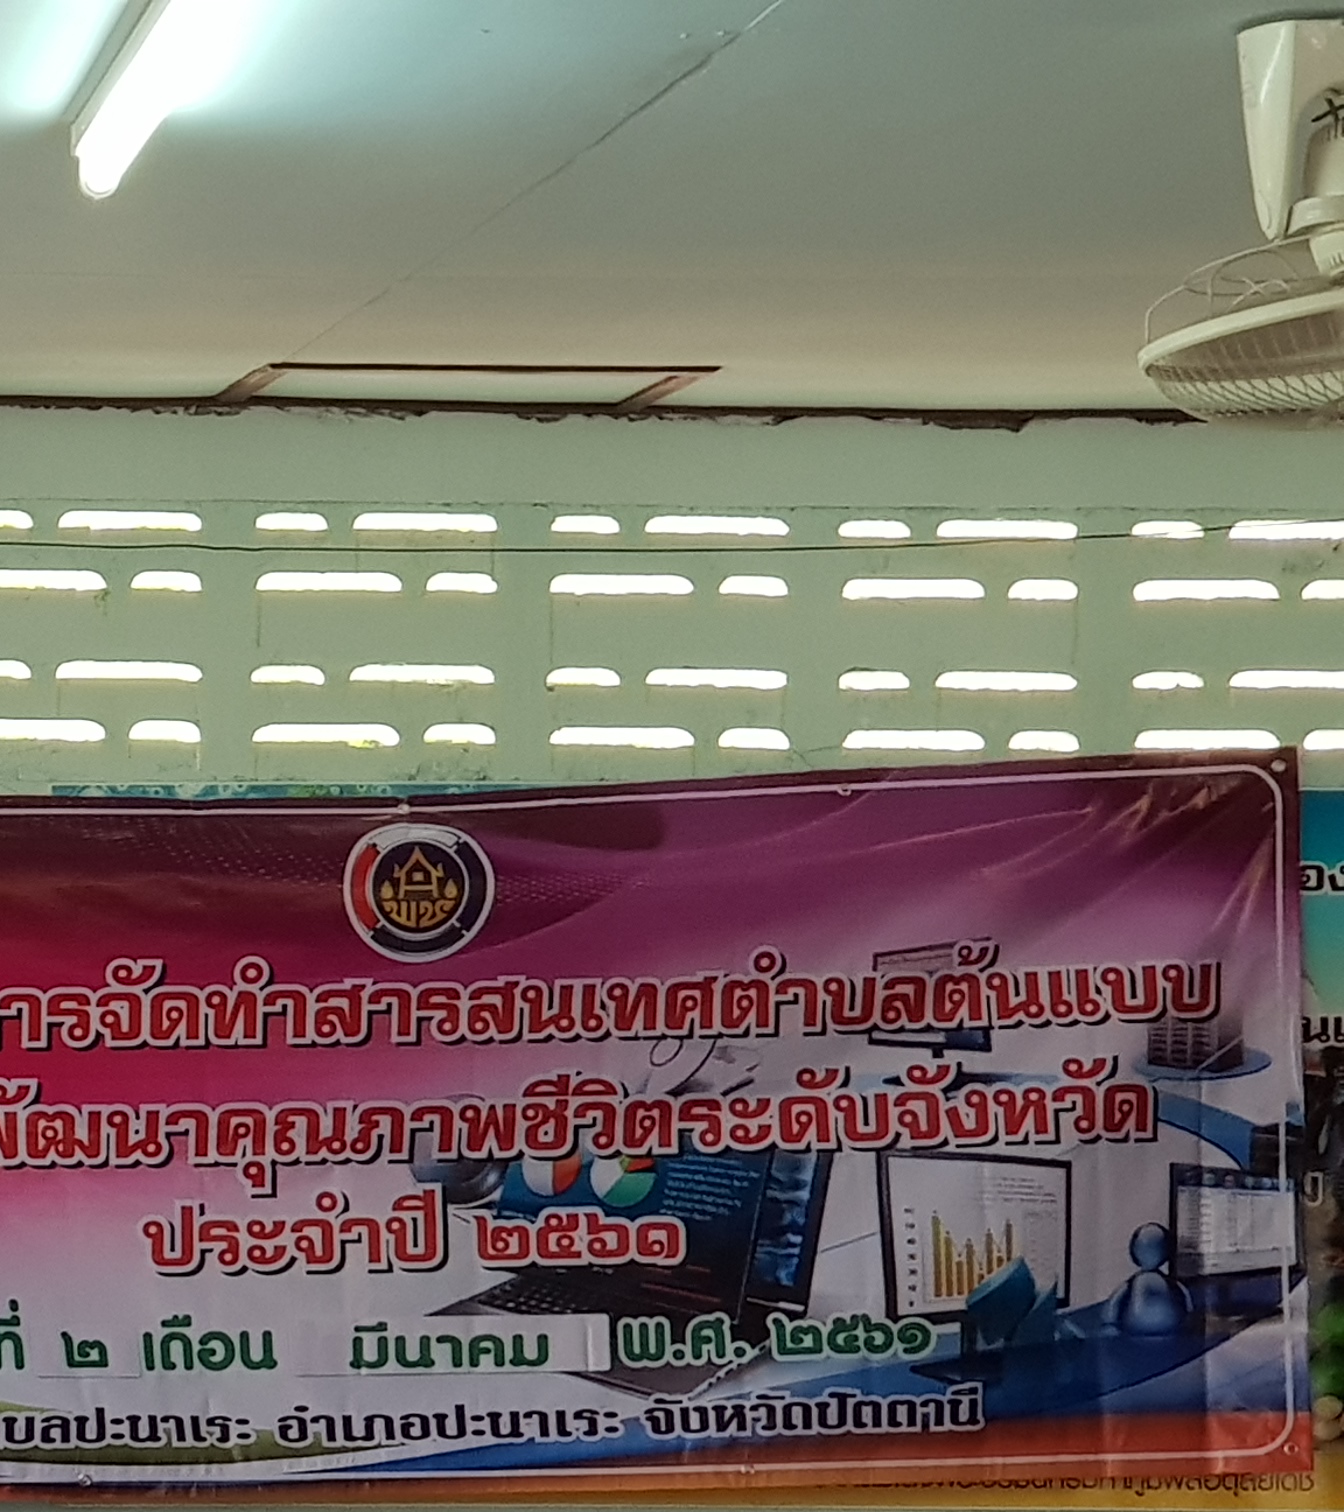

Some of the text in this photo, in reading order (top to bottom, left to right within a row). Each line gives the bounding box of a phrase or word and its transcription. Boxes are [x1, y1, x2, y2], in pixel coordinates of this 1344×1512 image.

[140, 1181, 688, 1272] ประจำปี ๒๕๖๑
[61, 1328, 110, 1370] ๒
[142, 1314, 278, 1372] เดือน
[348, 1320, 551, 1370] มีนาคม
[768, 1310, 938, 1361] ๒๕๖๑
[274, 1401, 623, 1450] อำเภอปะนาเระ
[642, 1380, 988, 1440] จังหวัดปัตตานี
